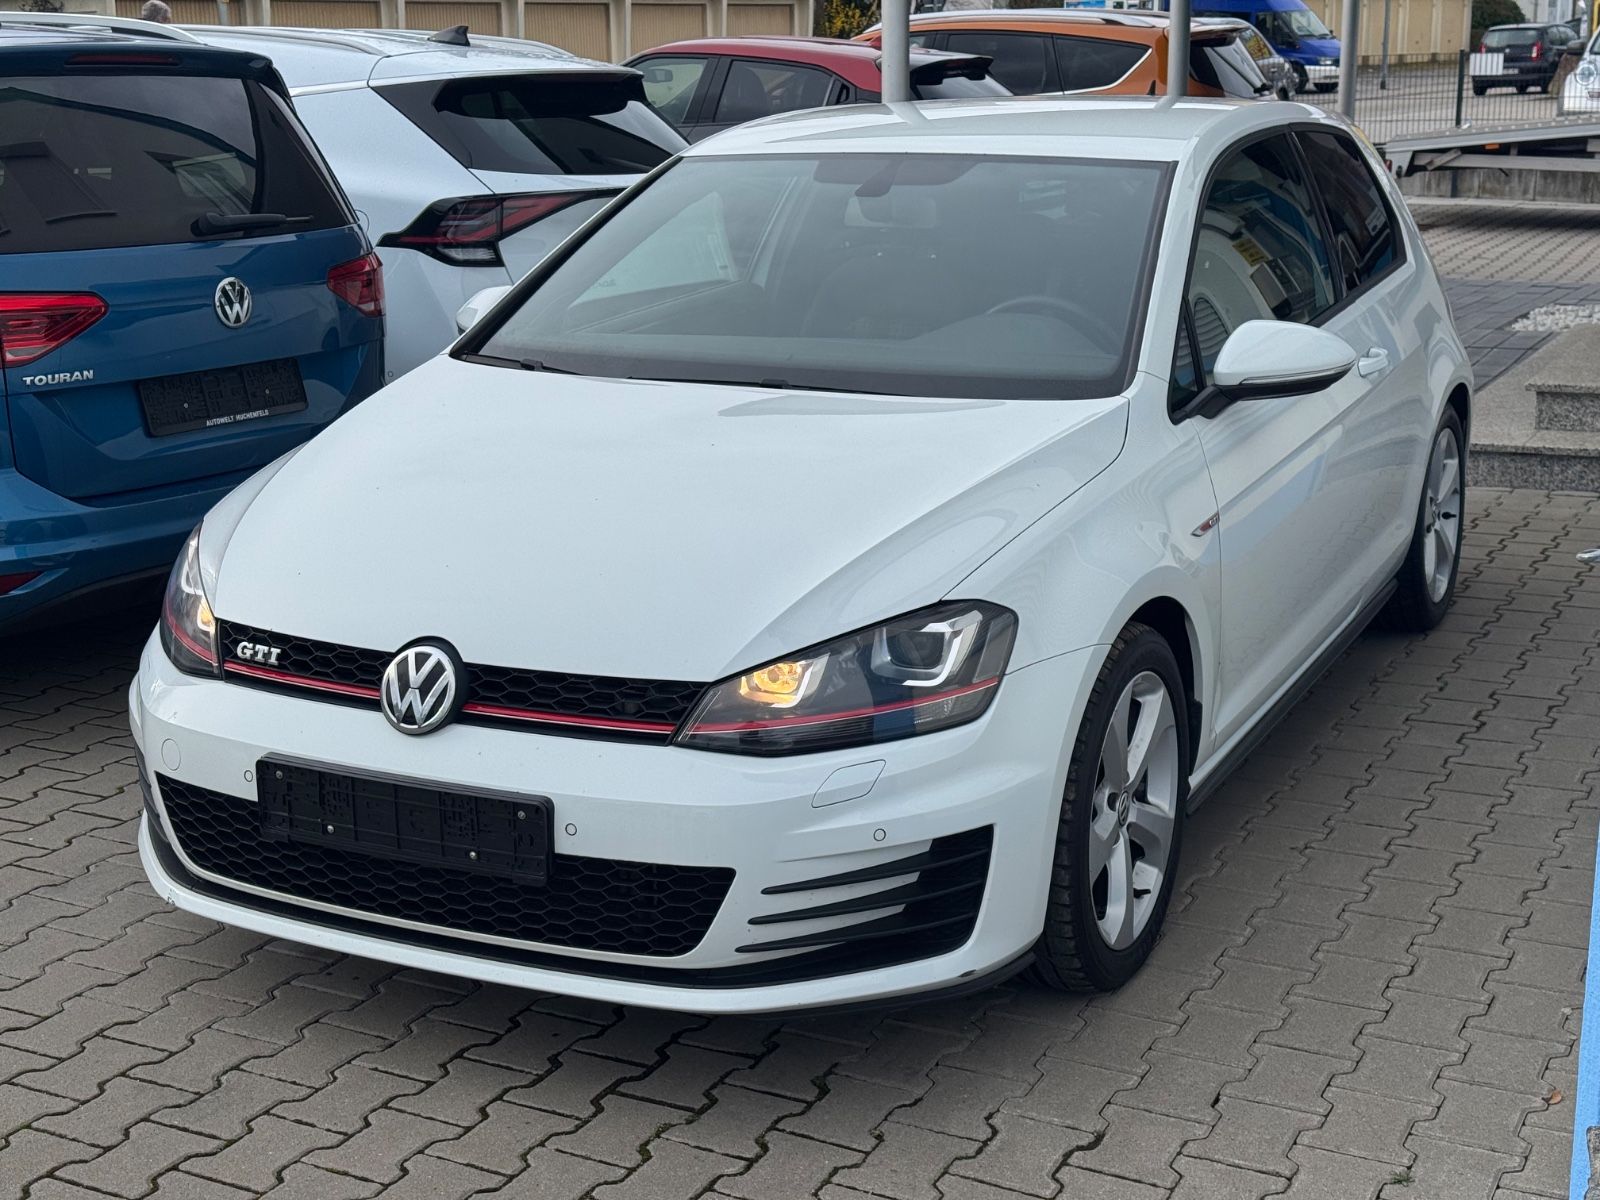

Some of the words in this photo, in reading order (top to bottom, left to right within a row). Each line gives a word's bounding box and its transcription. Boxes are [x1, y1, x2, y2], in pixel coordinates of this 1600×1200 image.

[215, 277, 252, 328] VW
[22, 369, 94, 386] TOURAN
[206, 415, 235, 427] AUTOWELT
[236, 641, 282, 666] GTI
[381, 645, 456, 734] VW
